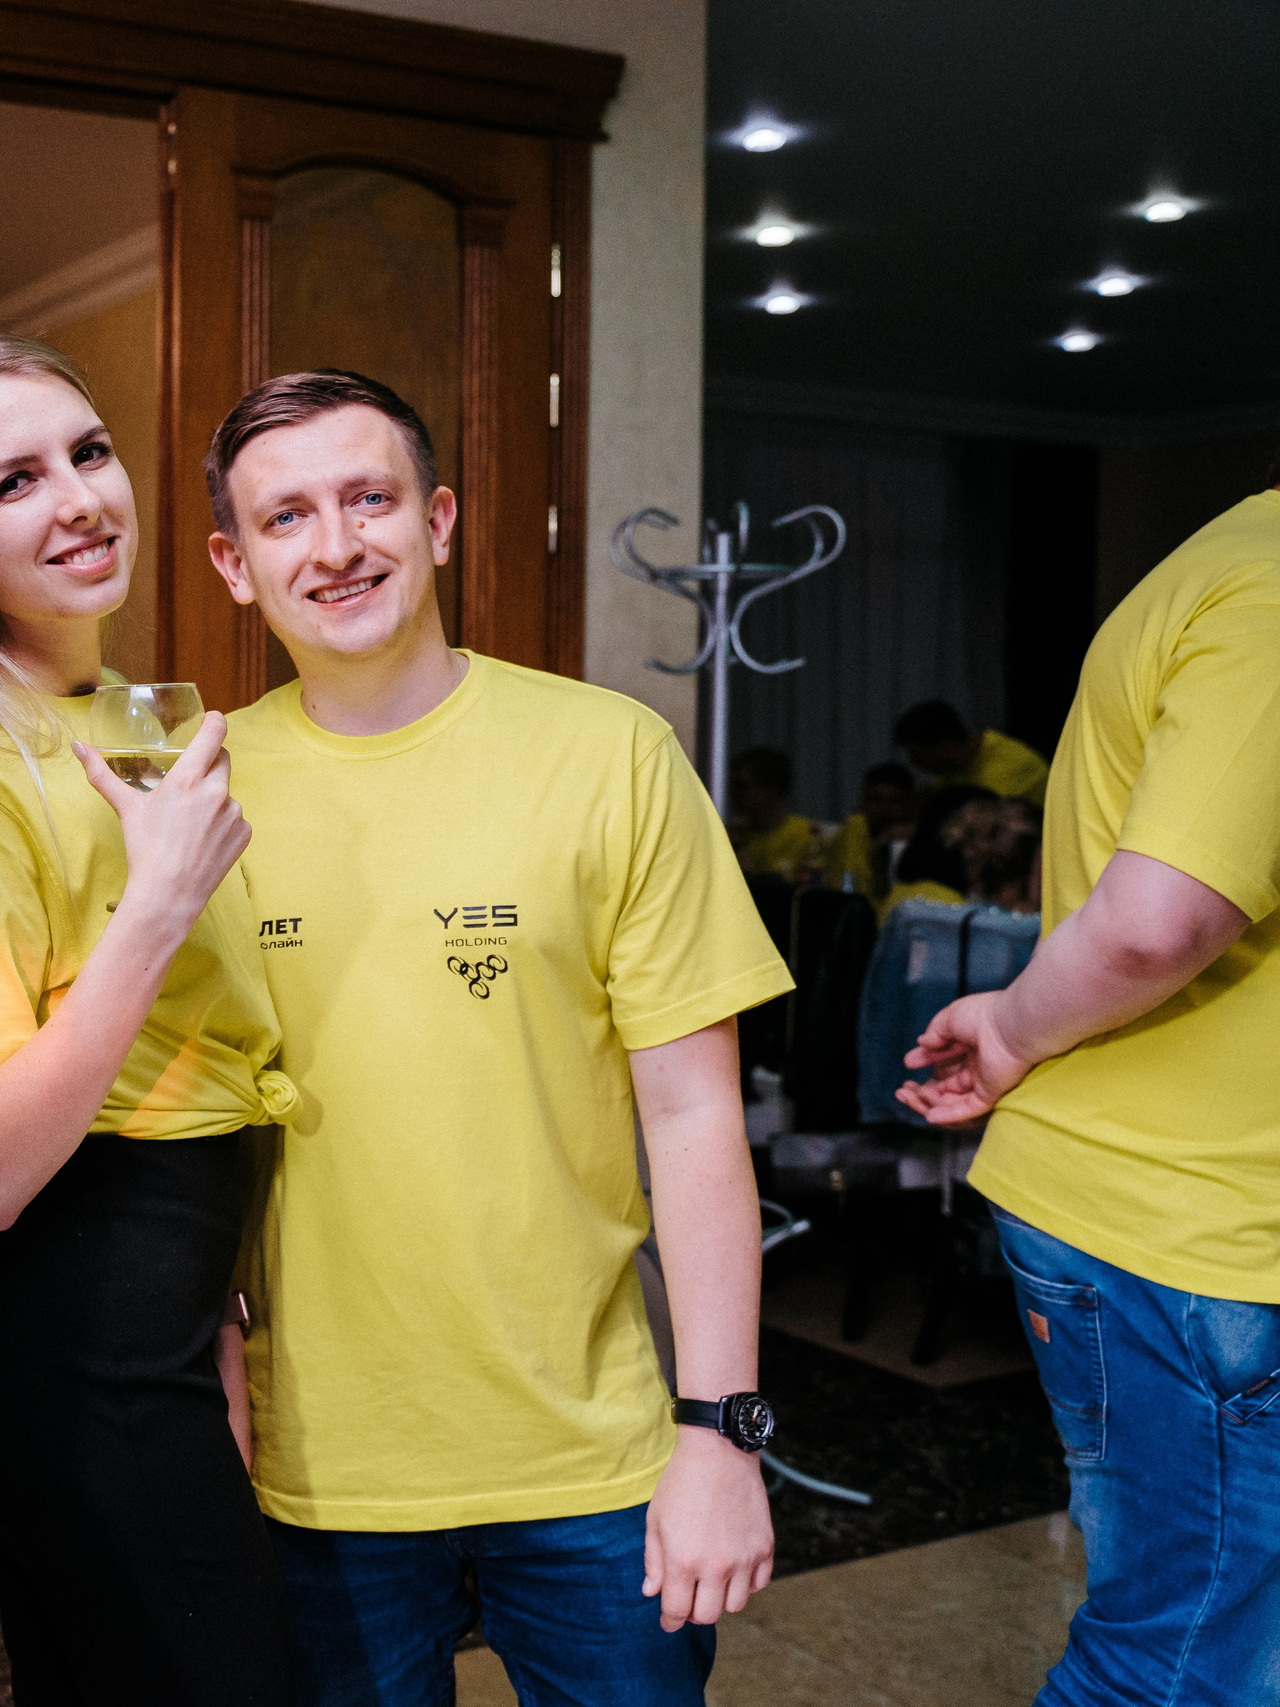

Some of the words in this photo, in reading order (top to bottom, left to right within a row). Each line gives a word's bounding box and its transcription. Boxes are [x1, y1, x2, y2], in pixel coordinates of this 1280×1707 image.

[259, 917, 302, 937] ЛЕТ
[433, 905, 518, 930] YES
[445, 936, 508, 948] HOLDING
